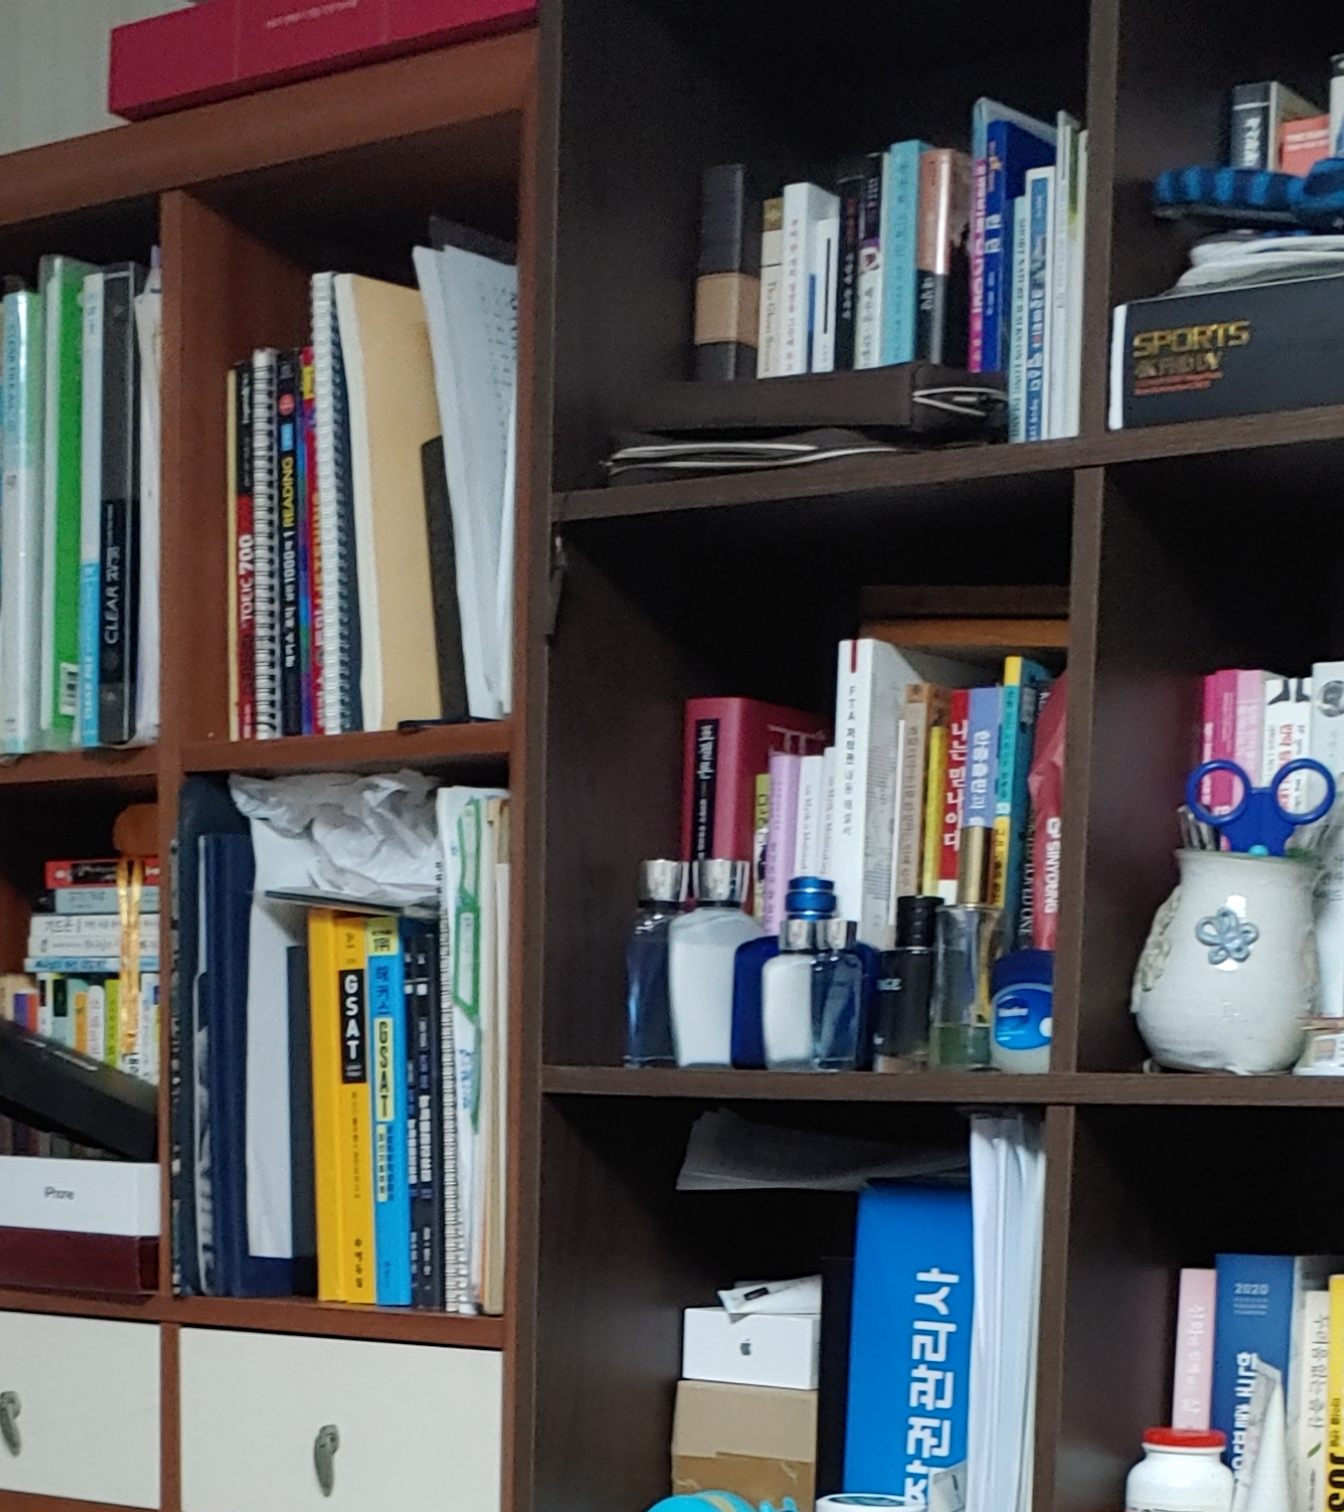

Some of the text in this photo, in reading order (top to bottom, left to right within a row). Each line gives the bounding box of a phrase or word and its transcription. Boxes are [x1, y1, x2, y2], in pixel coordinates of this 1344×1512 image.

[1132, 319, 1251, 358] SPORTS
[280, 456, 295, 528] READING
[105, 585, 119, 644] CLEAR
[238, 534, 254, 624] TOEIC 700
[1043, 840, 1062, 914] SINYOUNG
[342, 974, 362, 1061] GSAT
[376, 1020, 392, 1120] GSAT
[1233, 1282, 1270, 1297] 2020
